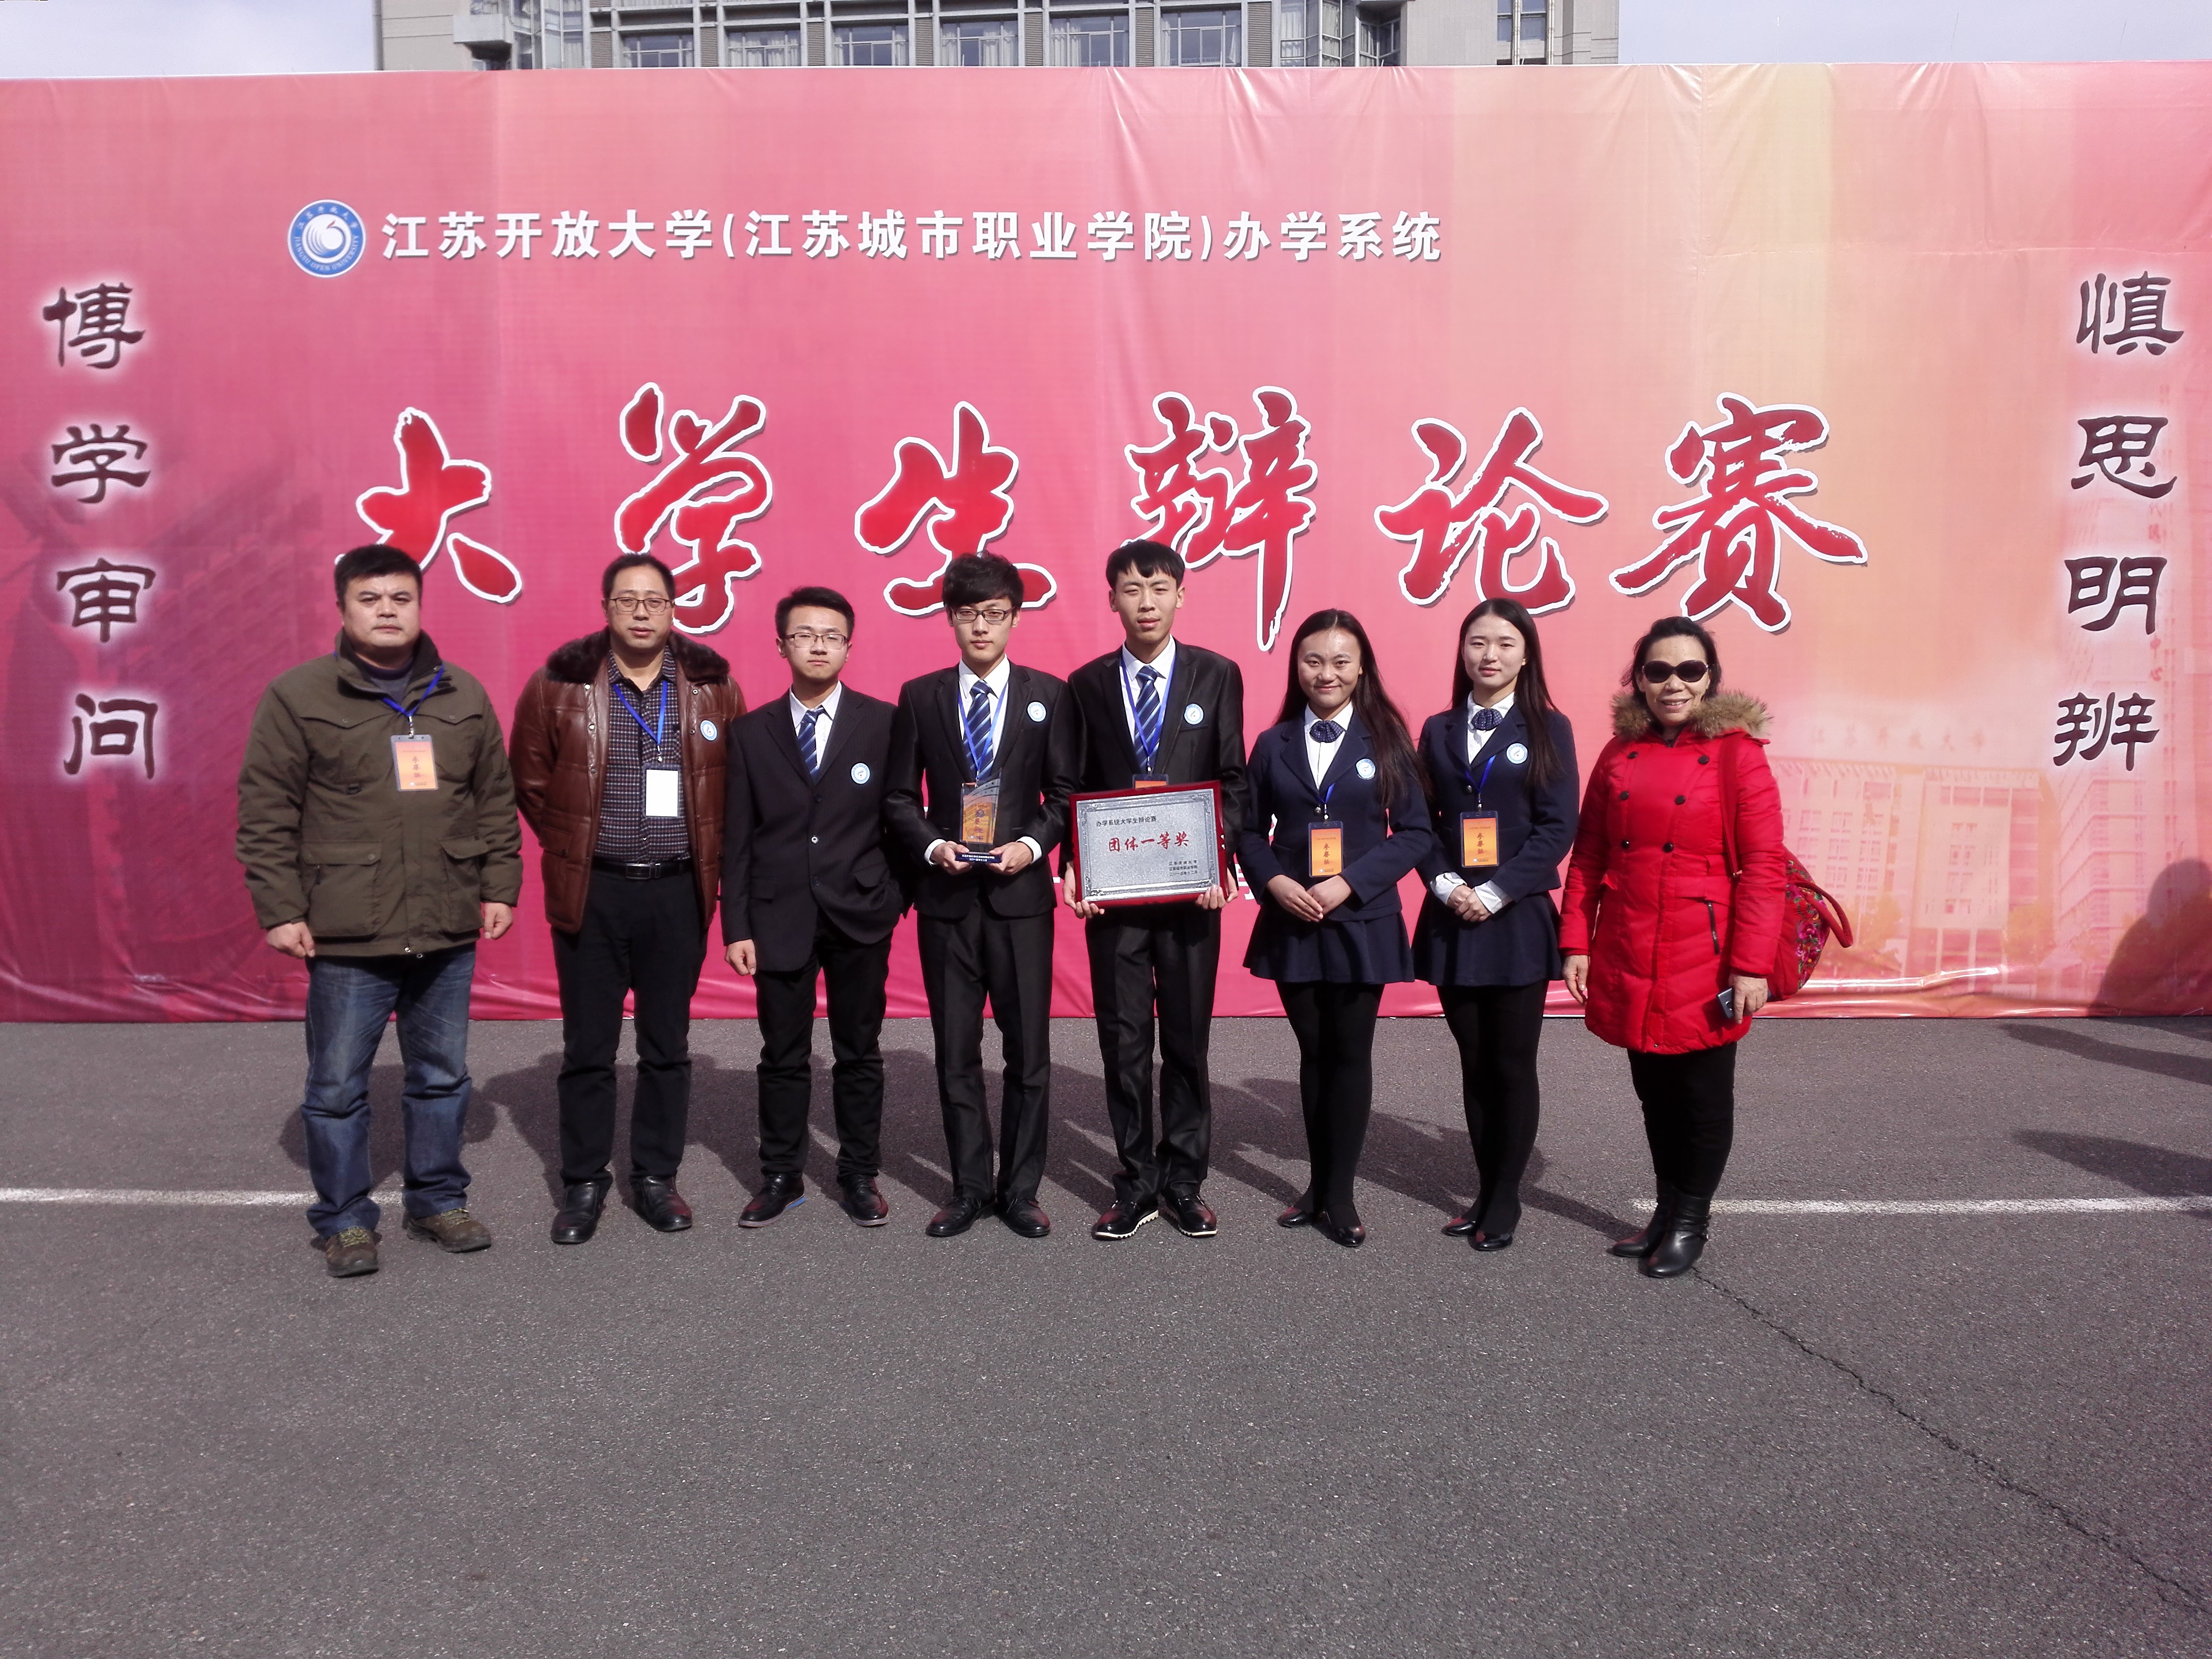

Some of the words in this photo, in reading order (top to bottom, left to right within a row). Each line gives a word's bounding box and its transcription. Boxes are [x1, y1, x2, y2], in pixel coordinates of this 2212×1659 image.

[382, 209, 1441, 261] 江苏开放大学(江苏城市职业学院)办学系统
[43, 282, 157, 779] 博学审问
[335, 381, 1869, 650] 大学生辩论赛
[2053, 271, 2184, 772] 慎思明辨
[1109, 831, 1189, 852] 团体一等奖
